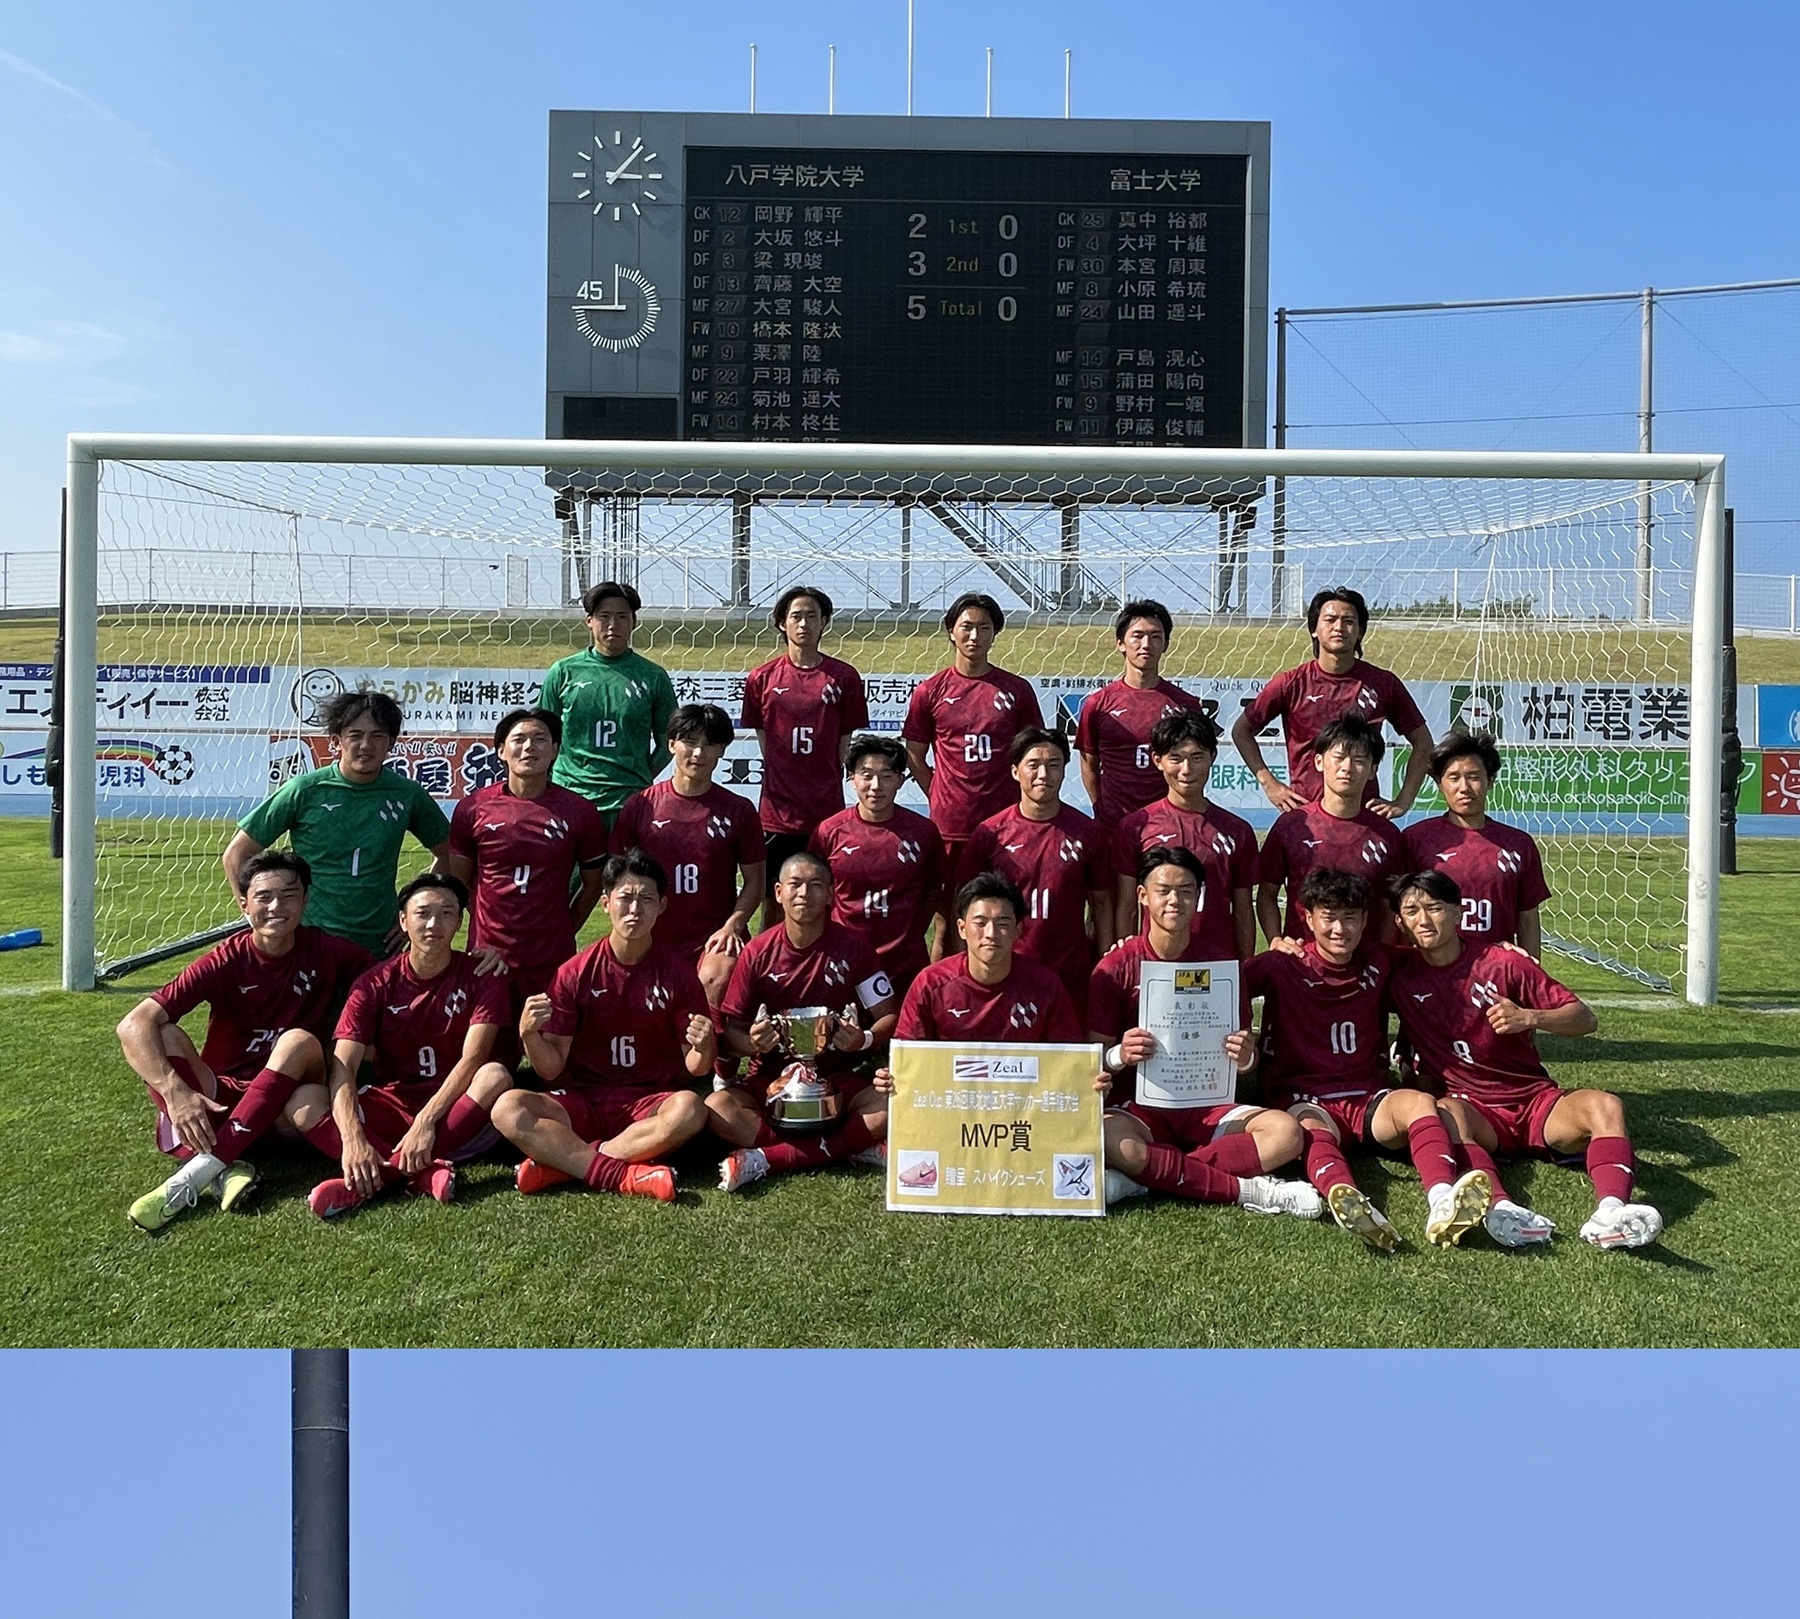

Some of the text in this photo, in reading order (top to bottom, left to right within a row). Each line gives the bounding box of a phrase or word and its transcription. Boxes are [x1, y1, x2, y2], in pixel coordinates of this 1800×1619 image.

[725, 164, 866, 188] 八戸学院大学
[1110, 168, 1202, 191] 富士大学
[755, 206, 793, 223] 岡野
[908, 213, 1018, 240] 2 1st 0
[754, 229, 793, 246] 大坂
[908, 251, 1018, 277] 3 2nd 0
[576, 280, 602, 300] 45
[907, 295, 1017, 321] 5 Total 0
[594, 720, 617, 748] 12
[792, 727, 814, 755] 15
[964, 733, 992, 763] 20
[1136, 745, 1151, 769] 6
[350, 849, 360, 876] 1
[513, 866, 531, 894] 4
[674, 865, 699, 894] 18
[864, 891, 889, 918] 14
[1030, 887, 1050, 919] 11
[1461, 898, 1492, 932] 29
[871, 975, 891, 997] C
[1331, 1021, 1358, 1054] 10
[418, 1046, 436, 1077] 9
[611, 1036, 637, 1067] 16
[1454, 1040, 1473, 1065] 8
[992, 1061, 1024, 1073] Zeal
[961, 1120, 1032, 1152] MVP賞
[973, 1168, 1046, 1187] スパイクシューズ
